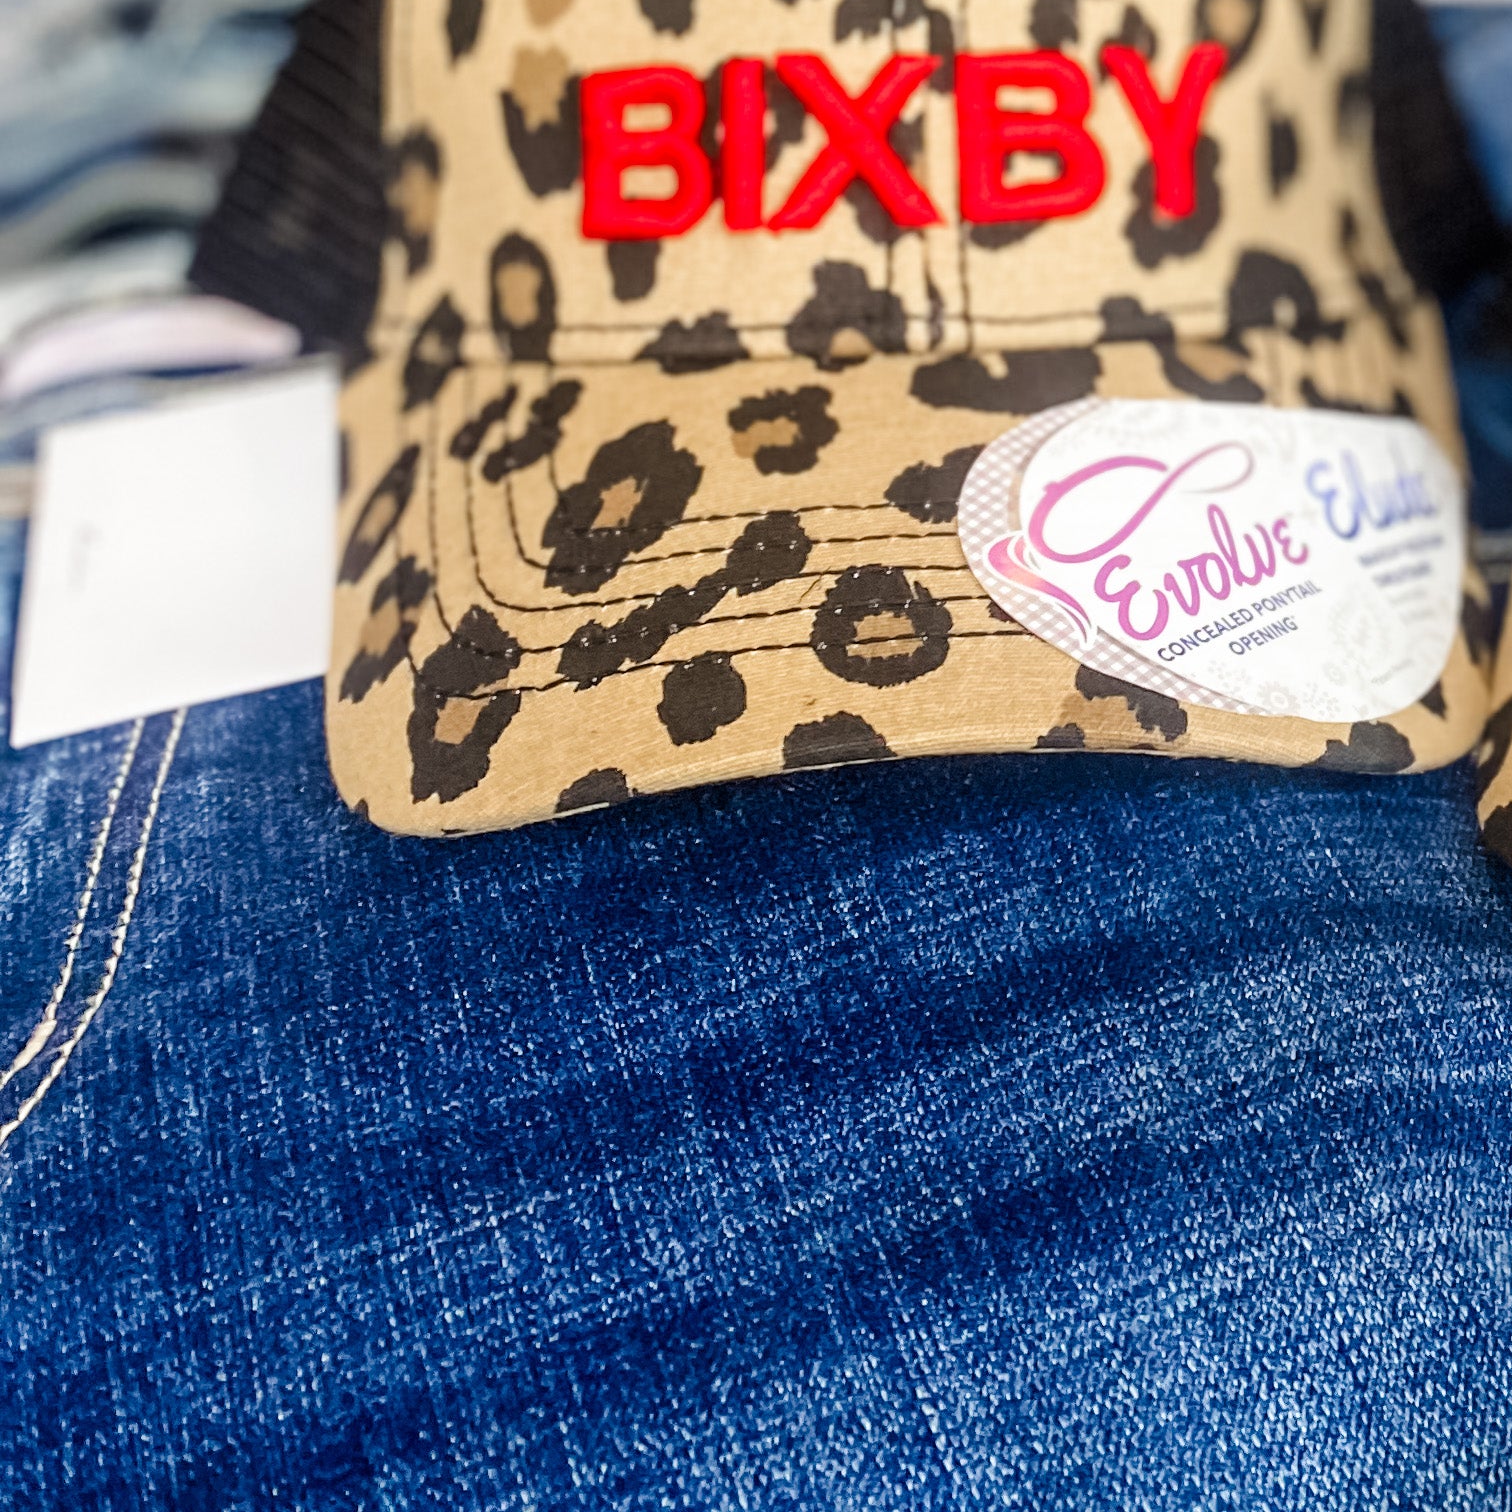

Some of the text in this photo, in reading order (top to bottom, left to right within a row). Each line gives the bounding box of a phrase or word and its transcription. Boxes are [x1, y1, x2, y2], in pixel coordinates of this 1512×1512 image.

[580, 42, 1226, 240] BIXBY
[1094, 503, 1310, 640] Evolve
[1157, 579, 1322, 662] CONCEALED PONYTAIL
